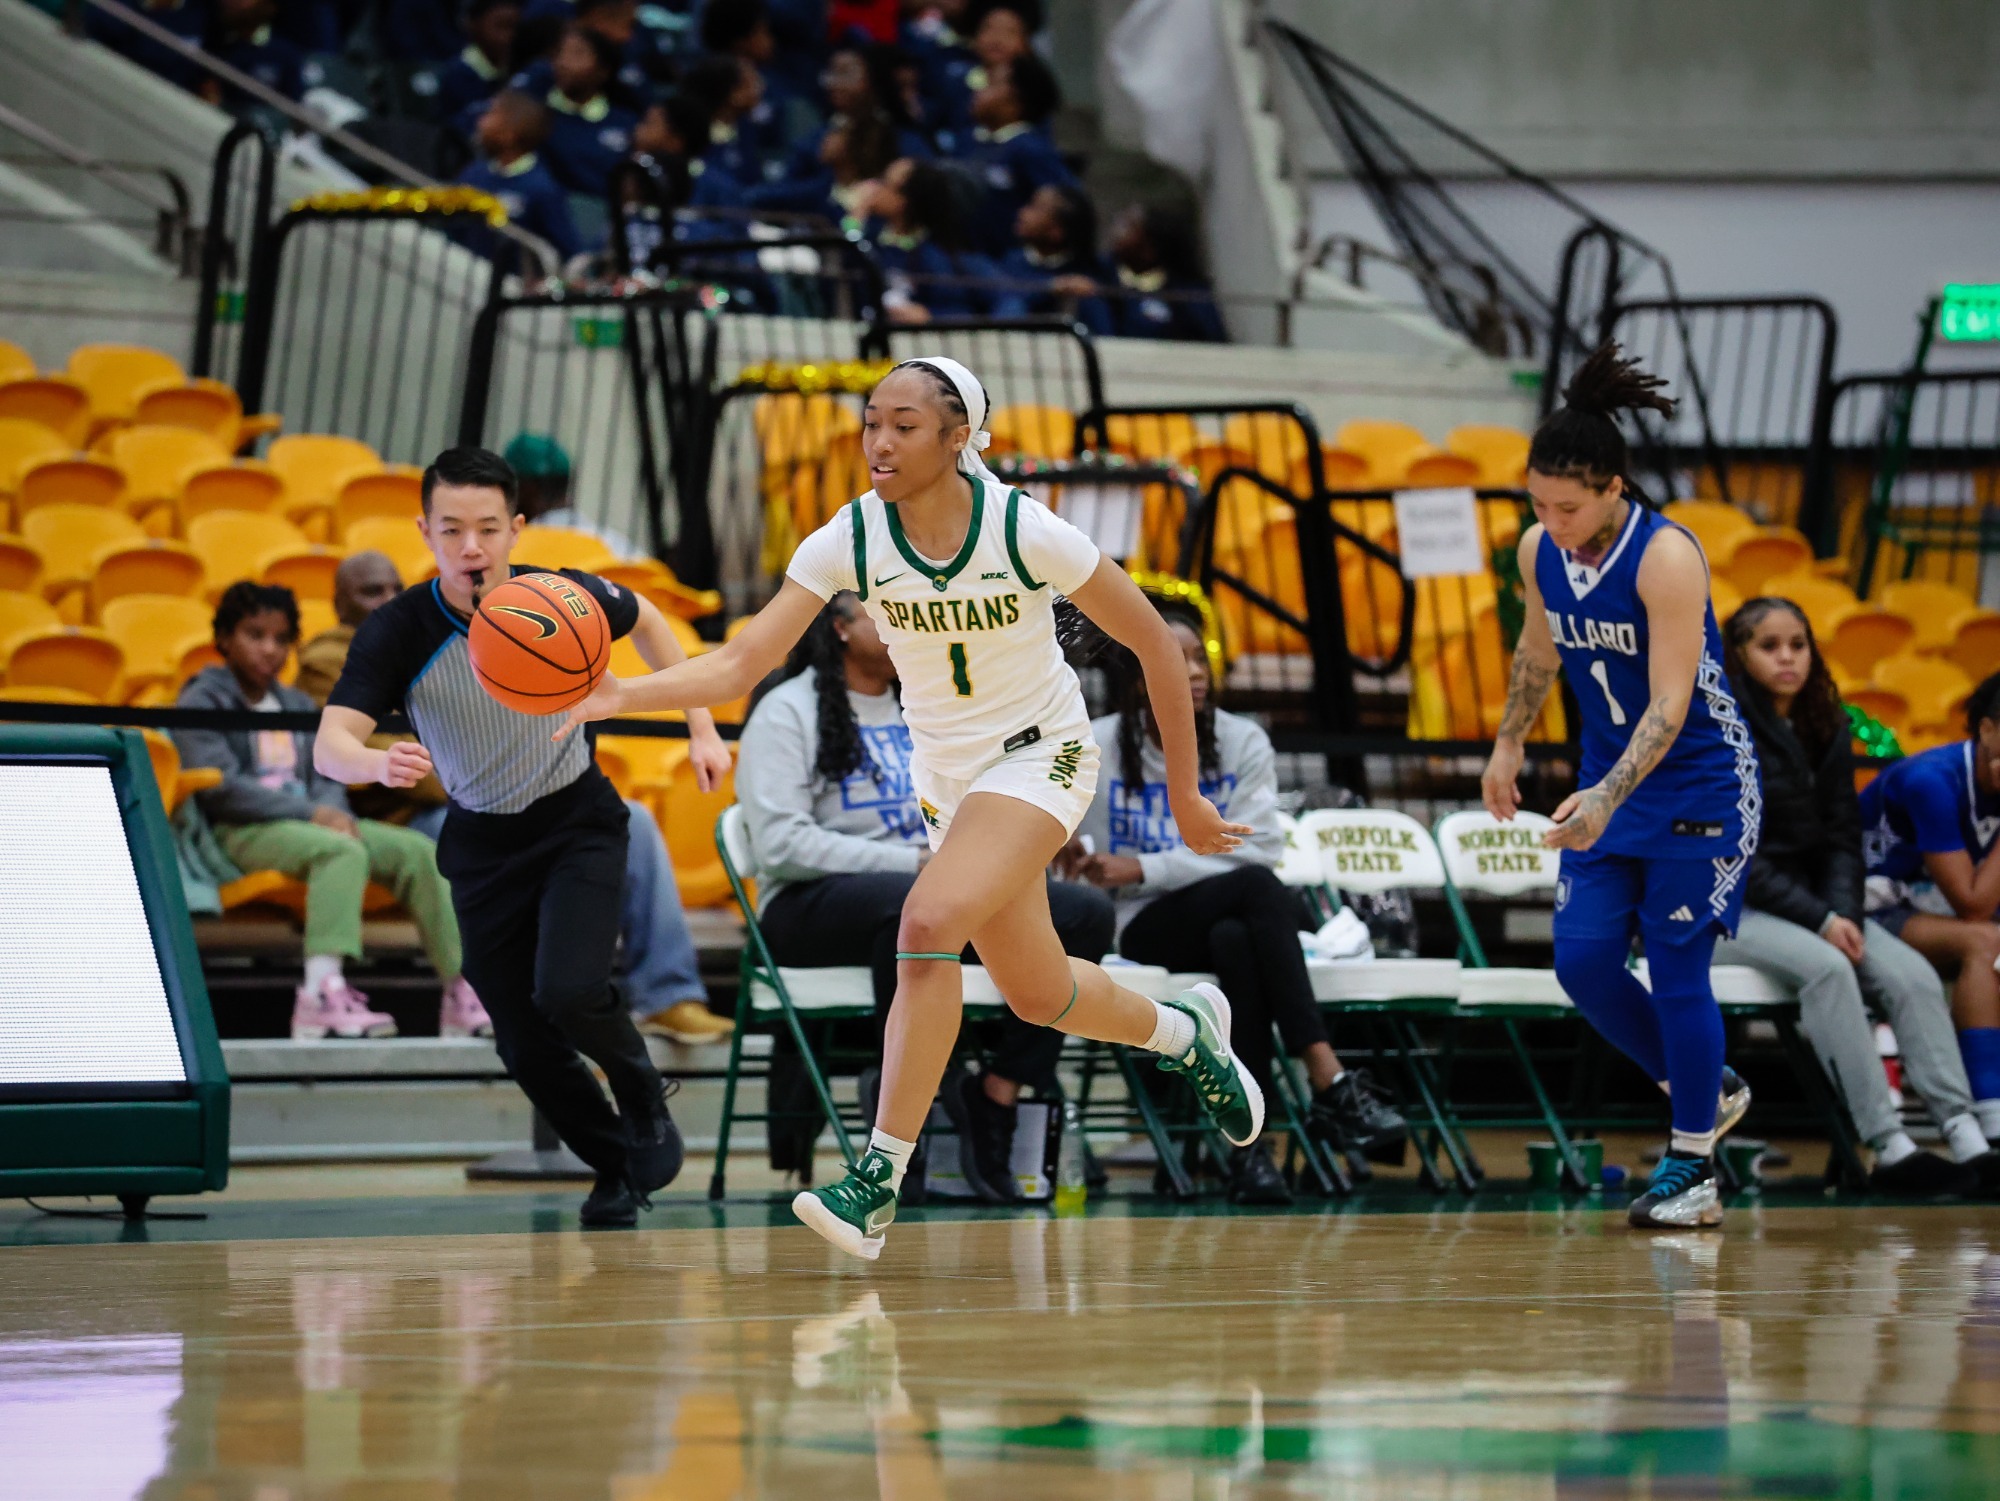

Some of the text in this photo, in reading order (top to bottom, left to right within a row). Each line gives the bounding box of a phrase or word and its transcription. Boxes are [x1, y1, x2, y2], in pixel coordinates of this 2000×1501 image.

[880, 593, 1020, 633] SPARTANS
[1545, 609, 1638, 656] ILLARD
[947, 641, 974, 698] 1
[1590, 660, 1627, 726] 1
[1316, 826, 1419, 851] NORFOLK
[1337, 851, 1403, 872] STATE
[1477, 852, 1543, 874] STATE
